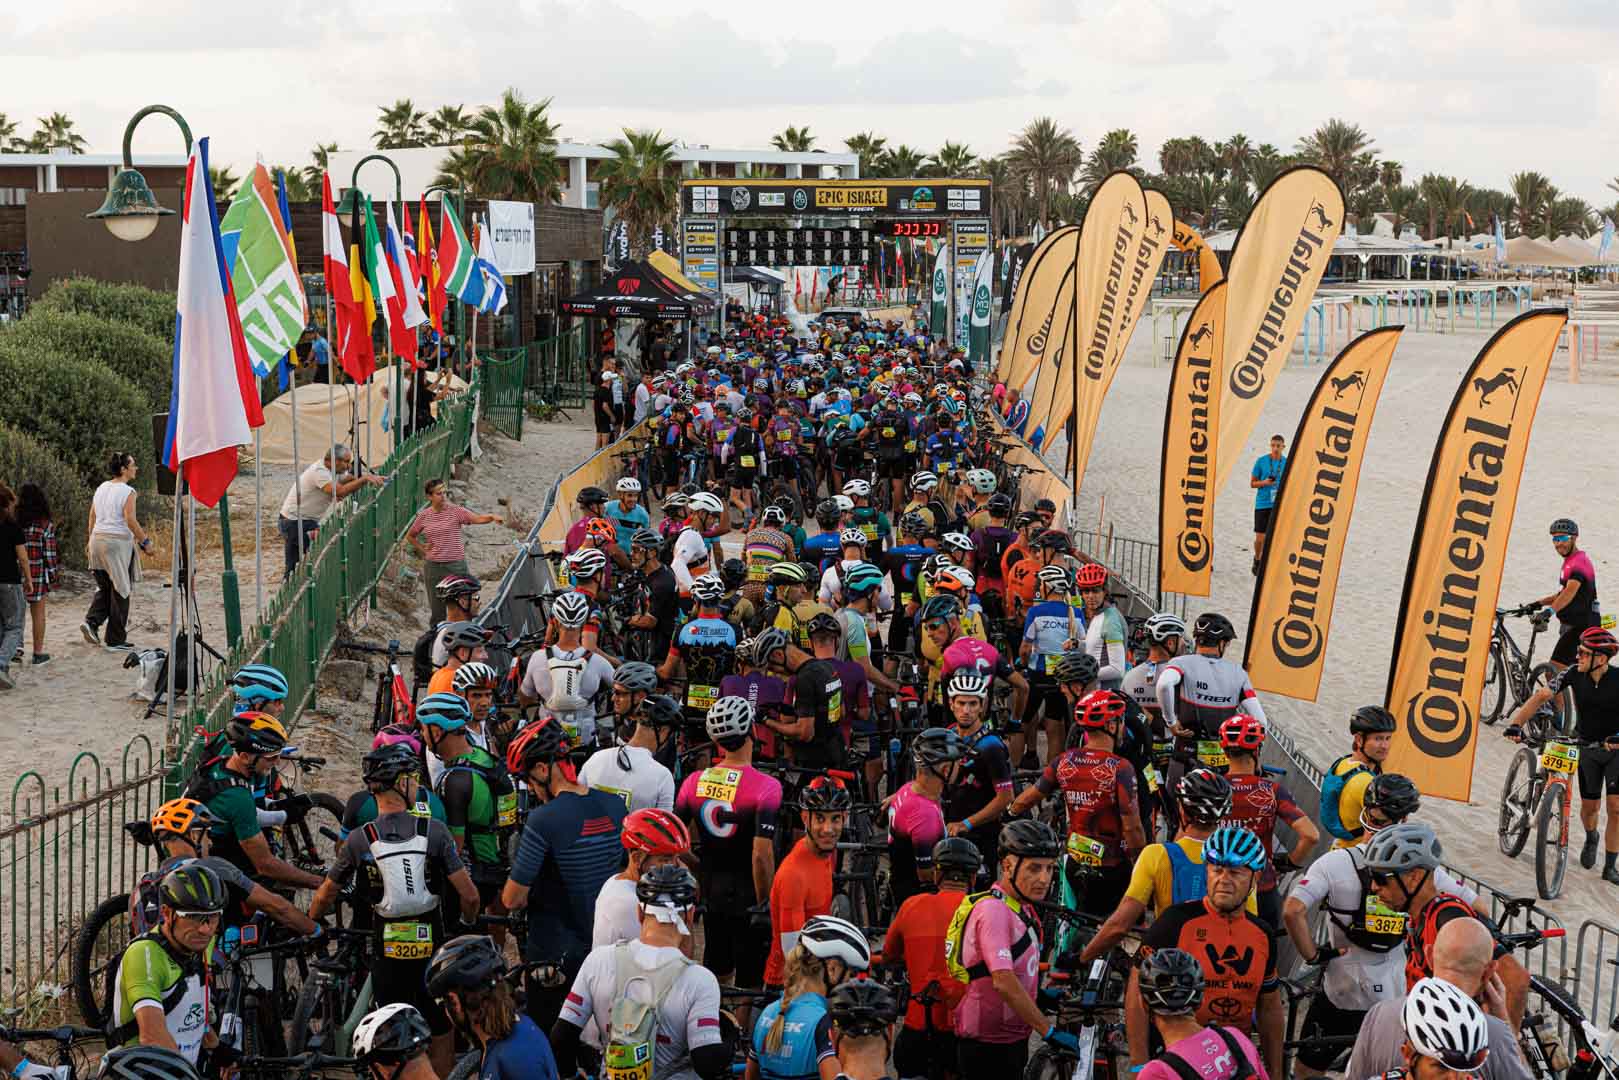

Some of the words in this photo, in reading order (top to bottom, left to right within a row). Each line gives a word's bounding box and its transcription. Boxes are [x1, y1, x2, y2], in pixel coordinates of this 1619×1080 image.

[818, 190, 843, 204] EPIC
[847, 190, 884, 204] ISRAEL
[1177, 357, 1212, 572] Continental
[1272, 406, 1358, 668] Continental
[1406, 416, 1512, 758] Continental
[1195, 692, 1232, 702] TREK
[1543, 755, 1574, 772] 379-1
[705, 785, 732, 801] 515-1
[402, 858, 415, 895] USWE
